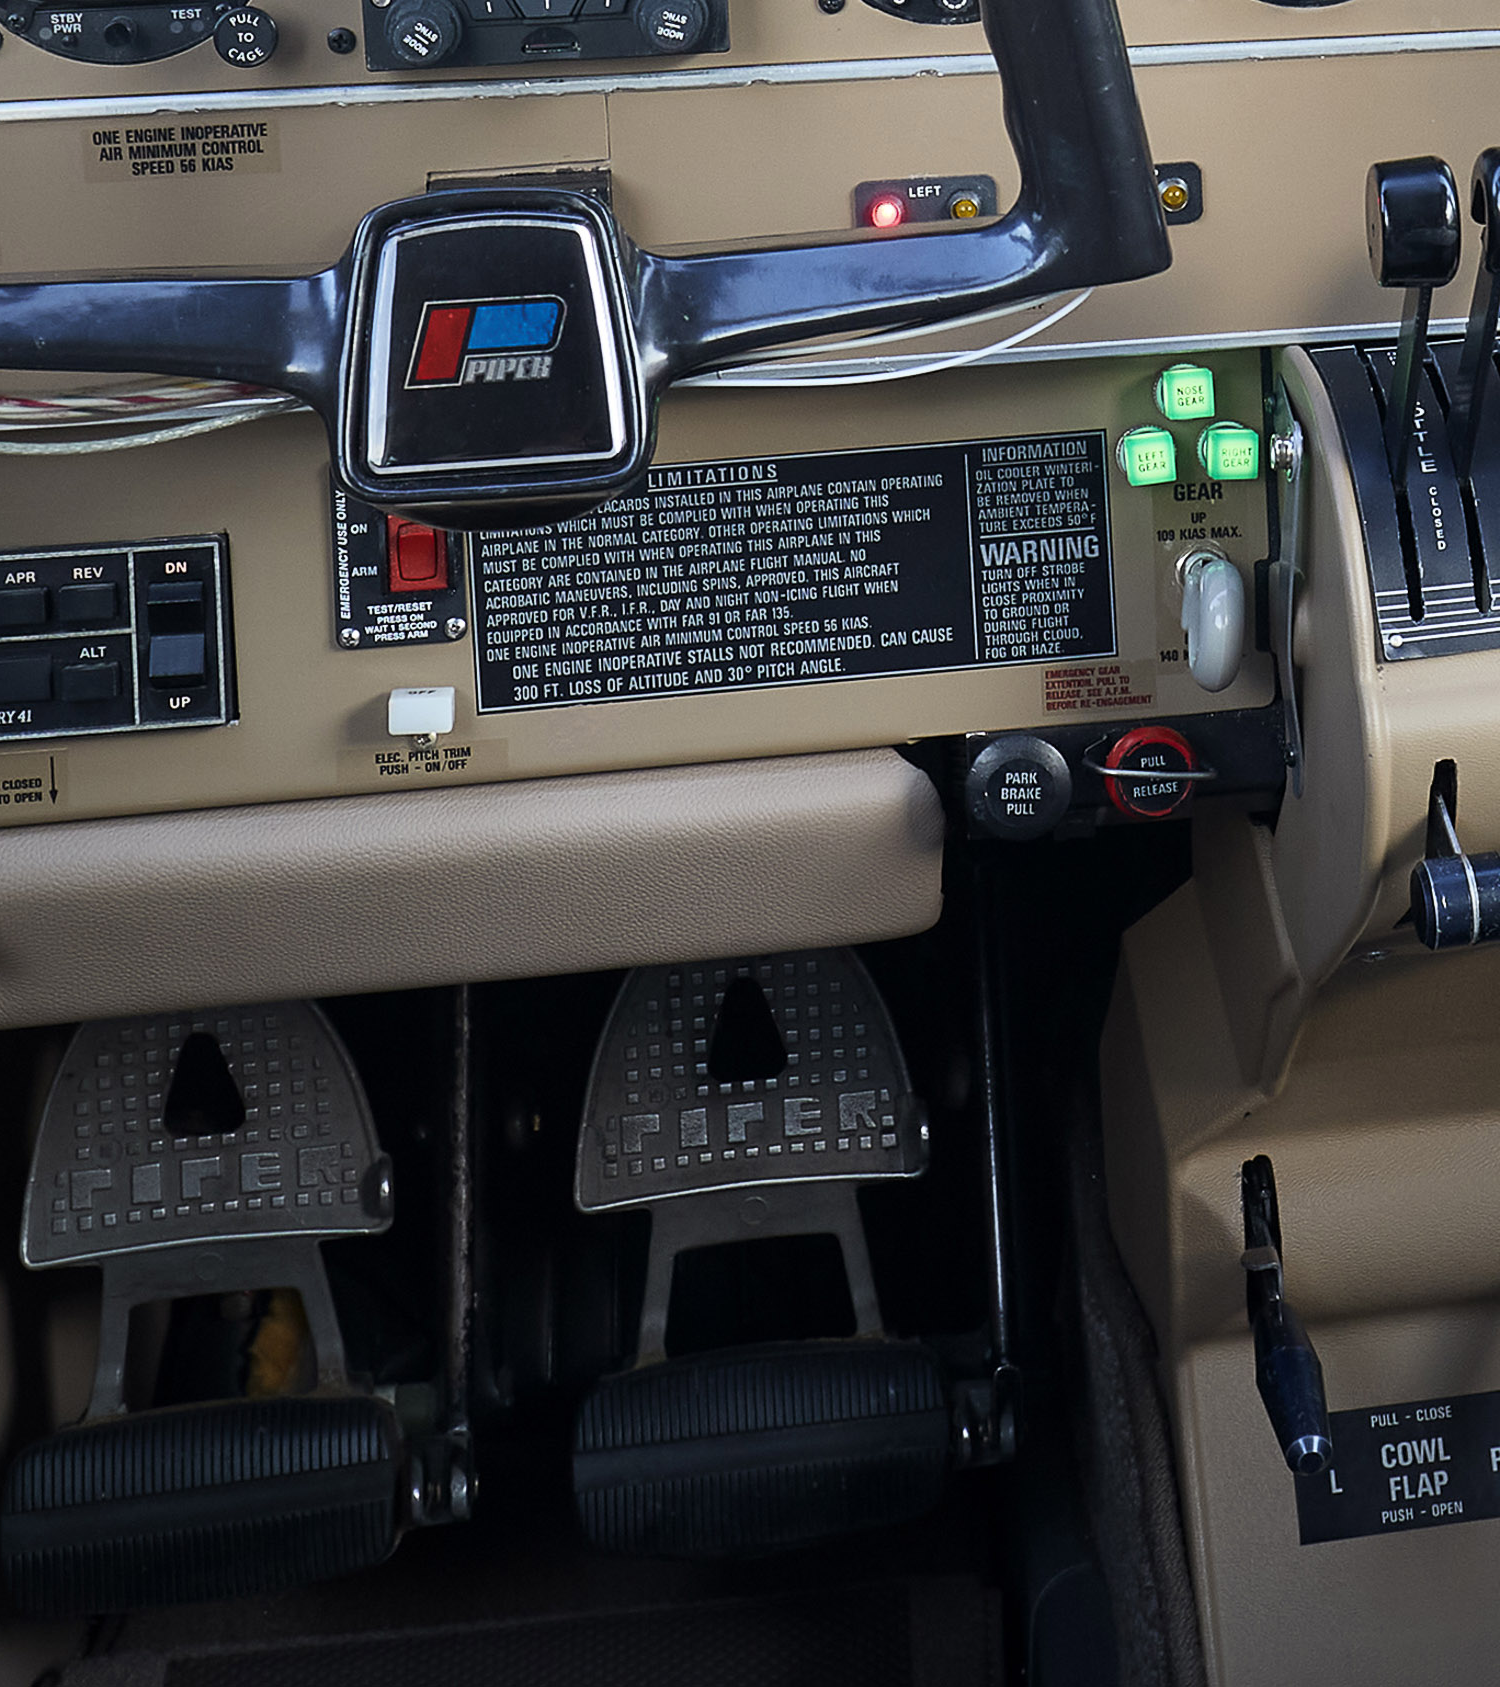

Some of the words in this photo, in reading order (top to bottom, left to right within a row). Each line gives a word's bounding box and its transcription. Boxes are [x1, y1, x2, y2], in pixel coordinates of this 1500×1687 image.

[229, 15, 259, 28] PULL
[237, 31, 253, 43] TO
[228, 48, 264, 62] CAGE
[93, 131, 120, 146] ONE
[125, 128, 175, 144] ENGINE
[180, 123, 267, 142] INOPERATIVE
[100, 146, 123, 161] AIR
[128, 143, 196, 159] MINIMUM
[201, 139, 264, 157] CONTROL
[132, 160, 175, 176] SPEED
[180, 159, 196, 174] 56
[201, 157, 233, 172] KIAS
[465, 357, 552, 384] PIPER
[981, 441, 1088, 462] INFORMATION
[647, 463, 779, 488] LIMITATIONS
[1157, 529, 1174, 542] 109
[1179, 527, 1207, 540] KIAS
[1211, 526, 1242, 539] MAX.
[980, 535, 1099, 567] WARNING
[73, 567, 103, 580] REV
[79, 646, 107, 659] ALT
[513, 684, 539, 701] 300
[543, 683, 562, 699] FT.
[566, 679, 600, 697] LOSS
[603, 678, 622, 694] OF
[625, 670, 689, 692] ALTITUDE
[693, 667, 722, 686] AND
[755, 661, 795, 680] PITCH
[799, 657, 847, 677] ANGLE.
[18, 709, 32, 723] 41
[1005, 772, 1037, 786] PARK
[1000, 786, 1042, 801] BRAKE
[1006, 801, 1035, 816] PULL
[615, 1091, 878, 1150] PIPER
[1380, 1437, 1451, 1468] COWL
[1389, 1471, 1450, 1501] FLAP
[1382, 1507, 1414, 1523] PUSH
[1432, 1501, 1464, 1518] OPEN
